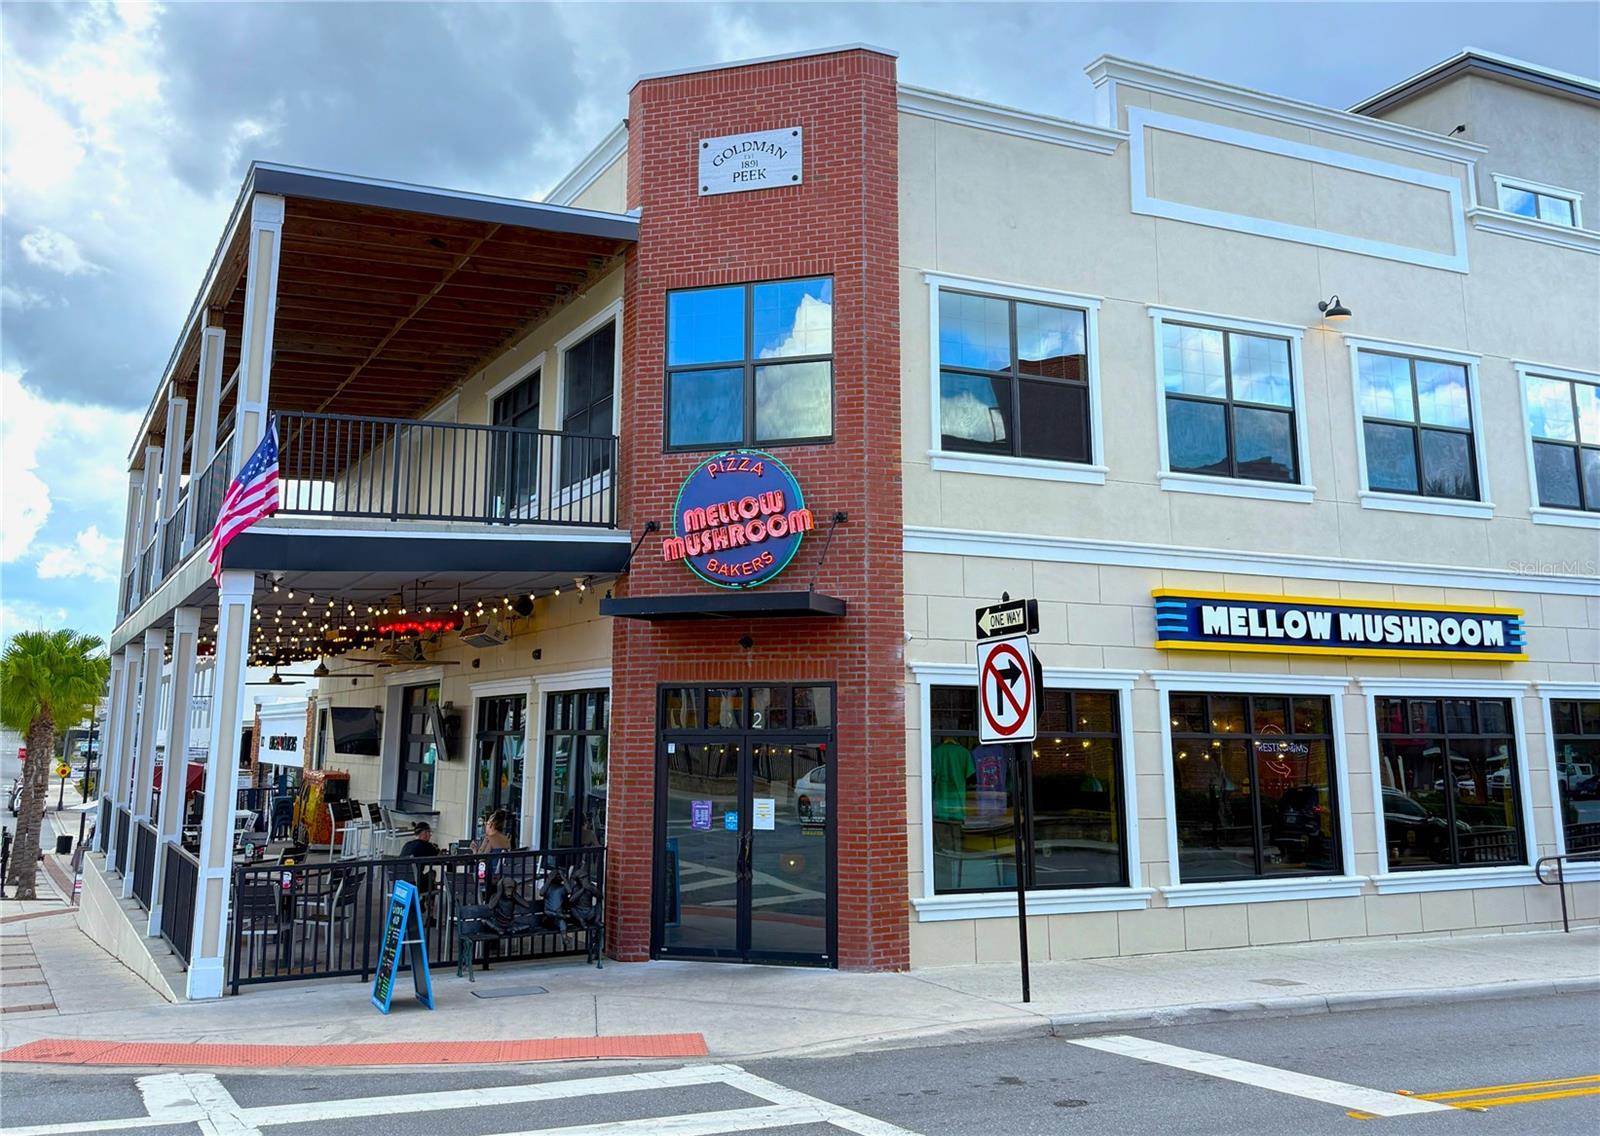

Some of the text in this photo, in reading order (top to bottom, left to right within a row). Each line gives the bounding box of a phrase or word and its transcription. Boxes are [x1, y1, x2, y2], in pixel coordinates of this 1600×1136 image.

[712, 140, 788, 167] GOLDMAN
[741, 159, 759, 169] 1891
[732, 168, 767, 183] PEEK
[707, 457, 764, 479] PIZZA
[683, 489, 785, 533] MELLOW
[662, 508, 815, 562] MUSHROOM
[706, 551, 774, 577] BAKERS
[990, 609, 1022, 627] ONE WAY
[1200, 604, 1506, 647] MELLOW MUSHROOM
[752, 712, 762, 729] 2
